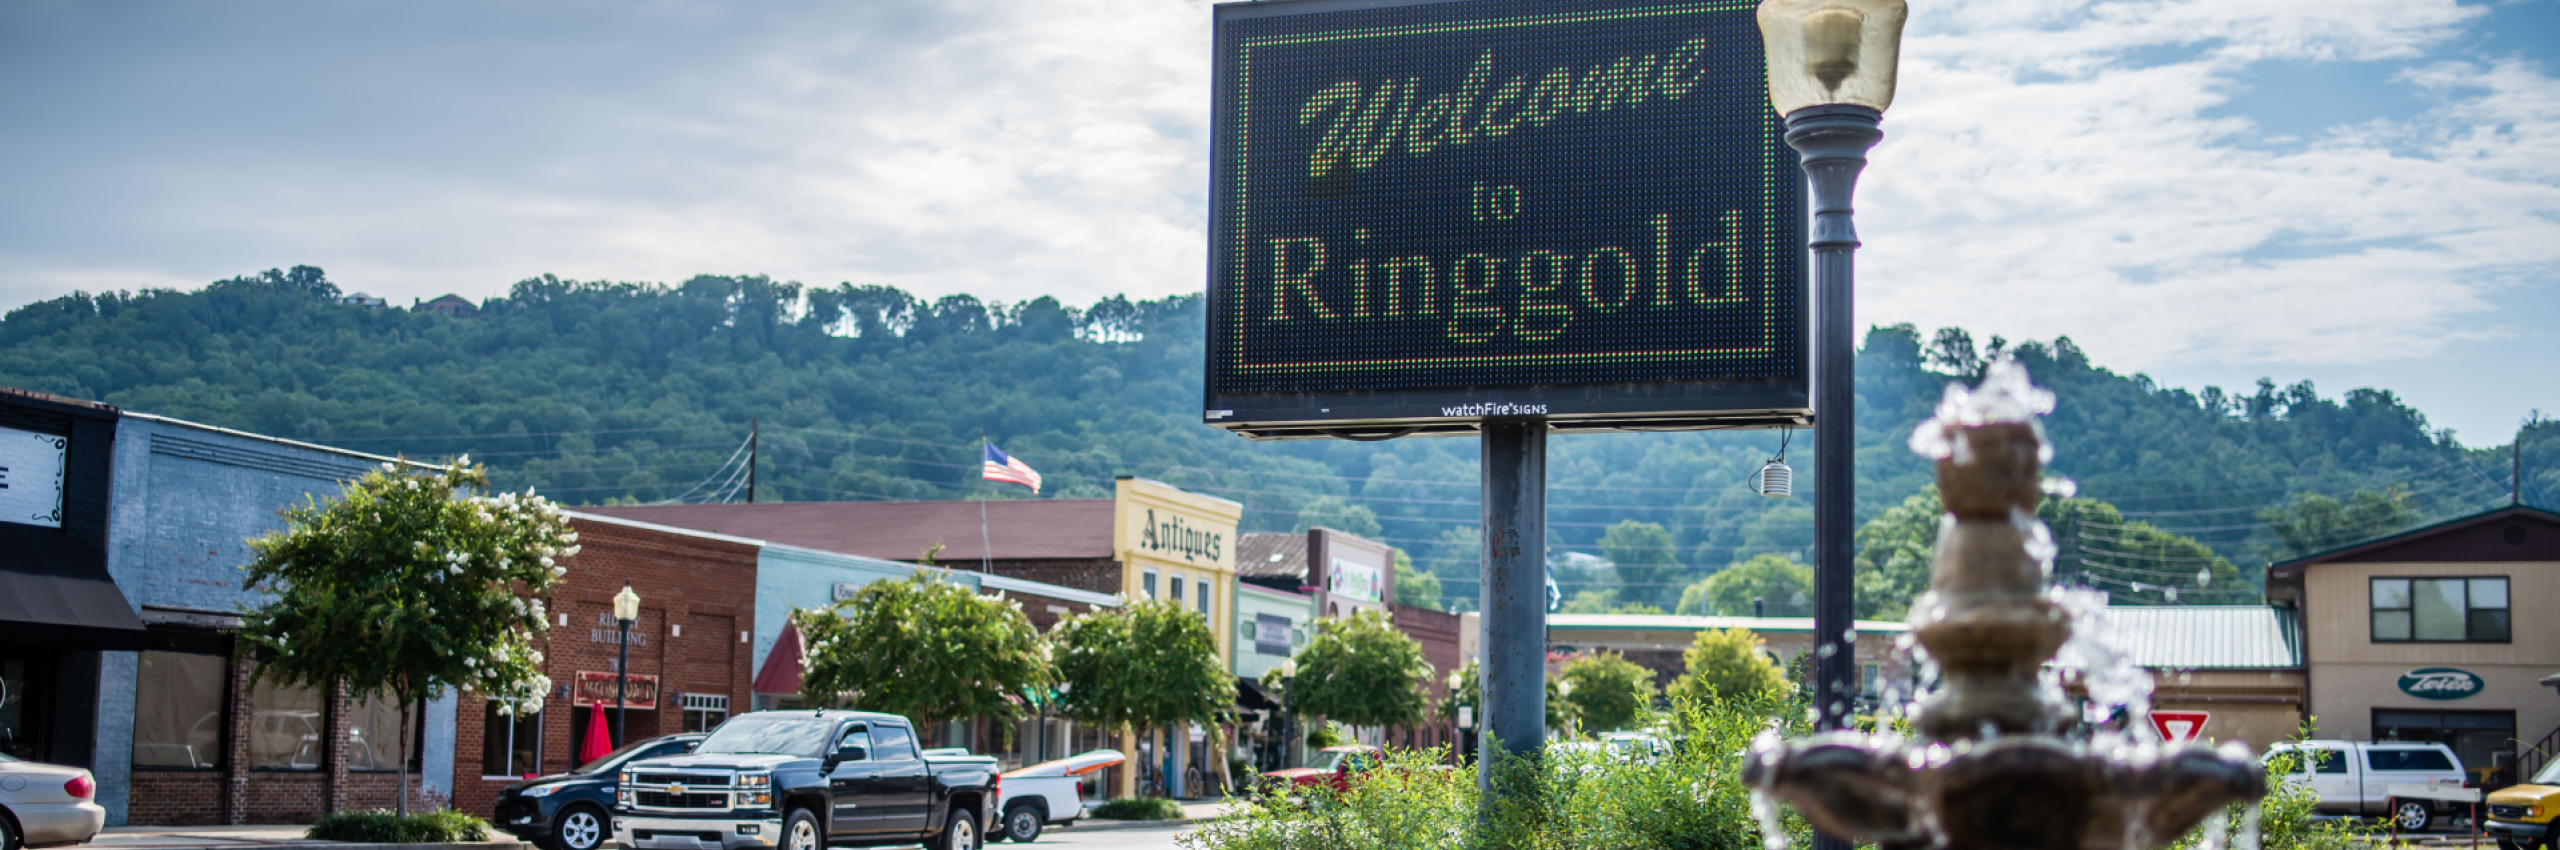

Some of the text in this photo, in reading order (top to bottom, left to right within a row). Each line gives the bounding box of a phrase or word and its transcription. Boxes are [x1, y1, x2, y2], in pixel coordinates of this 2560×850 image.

[1300, 37, 1705, 177] Welcome
[1472, 180, 1521, 221] to
[1264, 209, 1750, 344] Ringgold
[1141, 509, 1222, 563] Antiques
